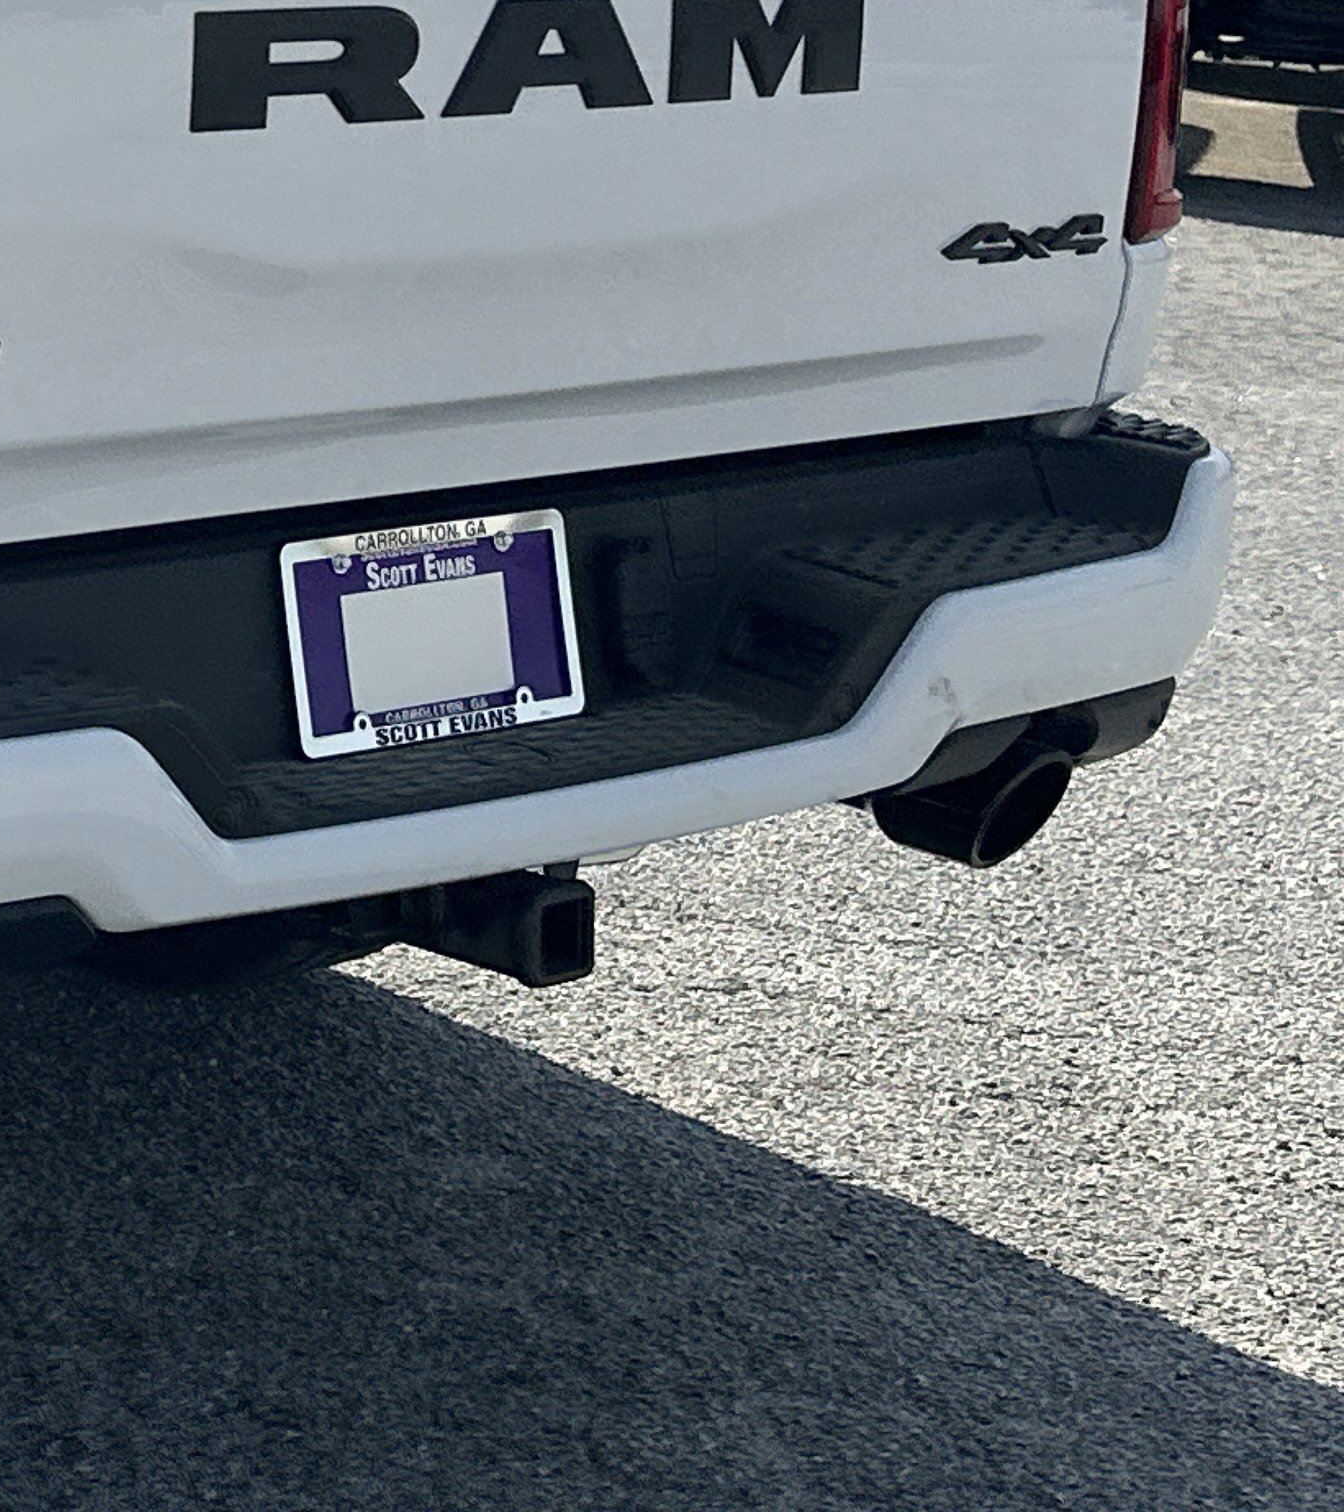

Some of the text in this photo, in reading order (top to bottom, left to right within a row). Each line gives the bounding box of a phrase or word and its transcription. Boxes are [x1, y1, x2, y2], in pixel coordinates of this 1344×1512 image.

[465, 519, 487, 537] GA
[375, 706, 518, 747] SCOTT EVANS
